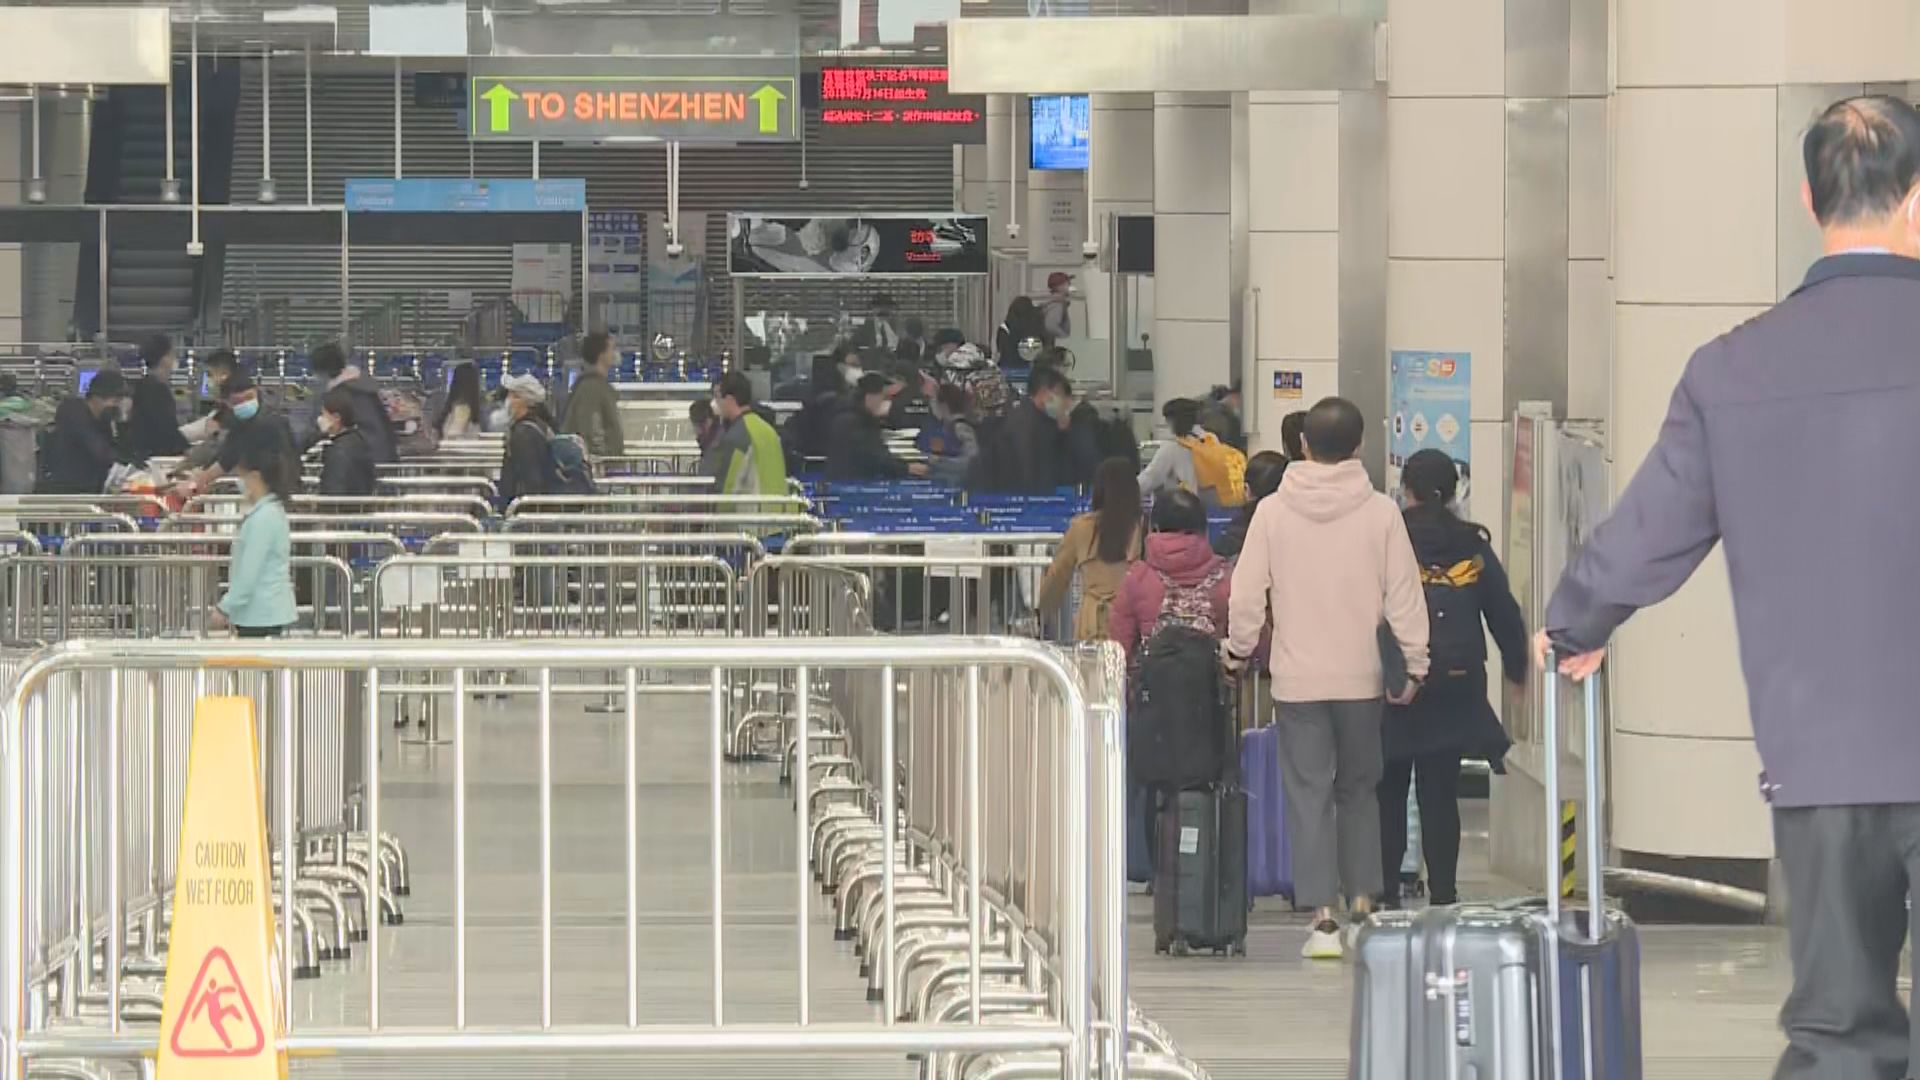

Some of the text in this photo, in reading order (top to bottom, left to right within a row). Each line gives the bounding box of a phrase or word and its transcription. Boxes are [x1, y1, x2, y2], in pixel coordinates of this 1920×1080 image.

[522, 92, 745, 120] TO SHENZHEN
[195, 841, 246, 869] CAUTION
[186, 879, 254, 905] WET FLOOR
